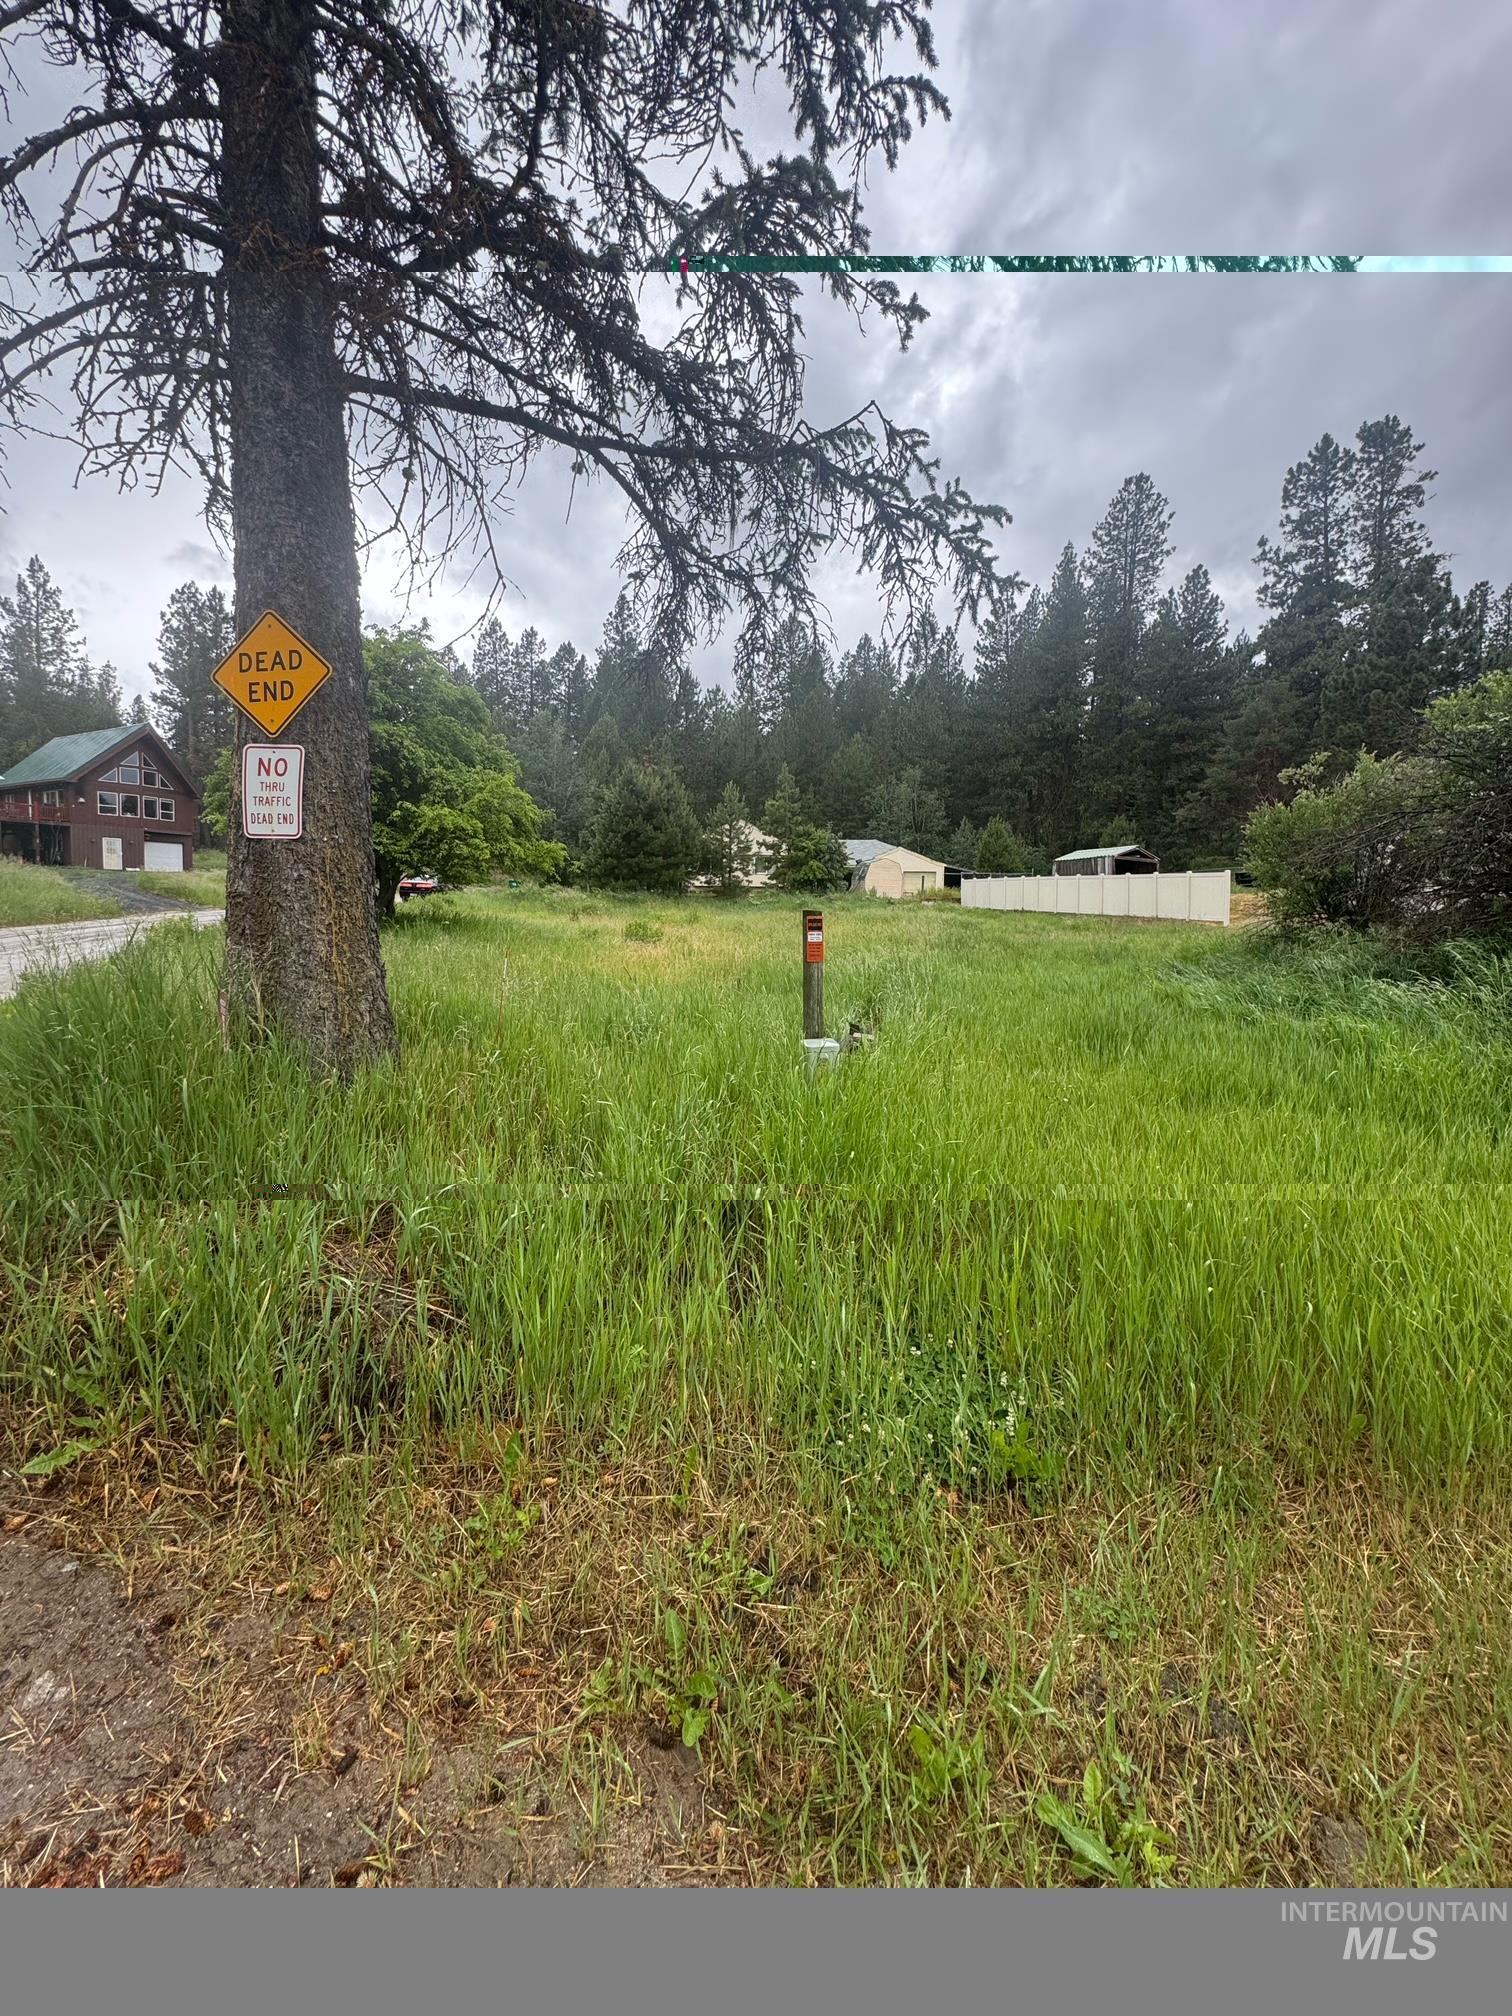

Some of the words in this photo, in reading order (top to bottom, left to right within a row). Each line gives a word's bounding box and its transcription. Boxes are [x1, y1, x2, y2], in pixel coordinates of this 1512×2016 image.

[239, 650, 303, 673] DEAD
[248, 680, 295, 703] END
[257, 757, 288, 777] NO
[260, 781, 285, 792] THRU
[253, 796, 292, 807] TRAFFIC
[250, 812, 273, 825] DEAD
[277, 812, 295, 825] END
